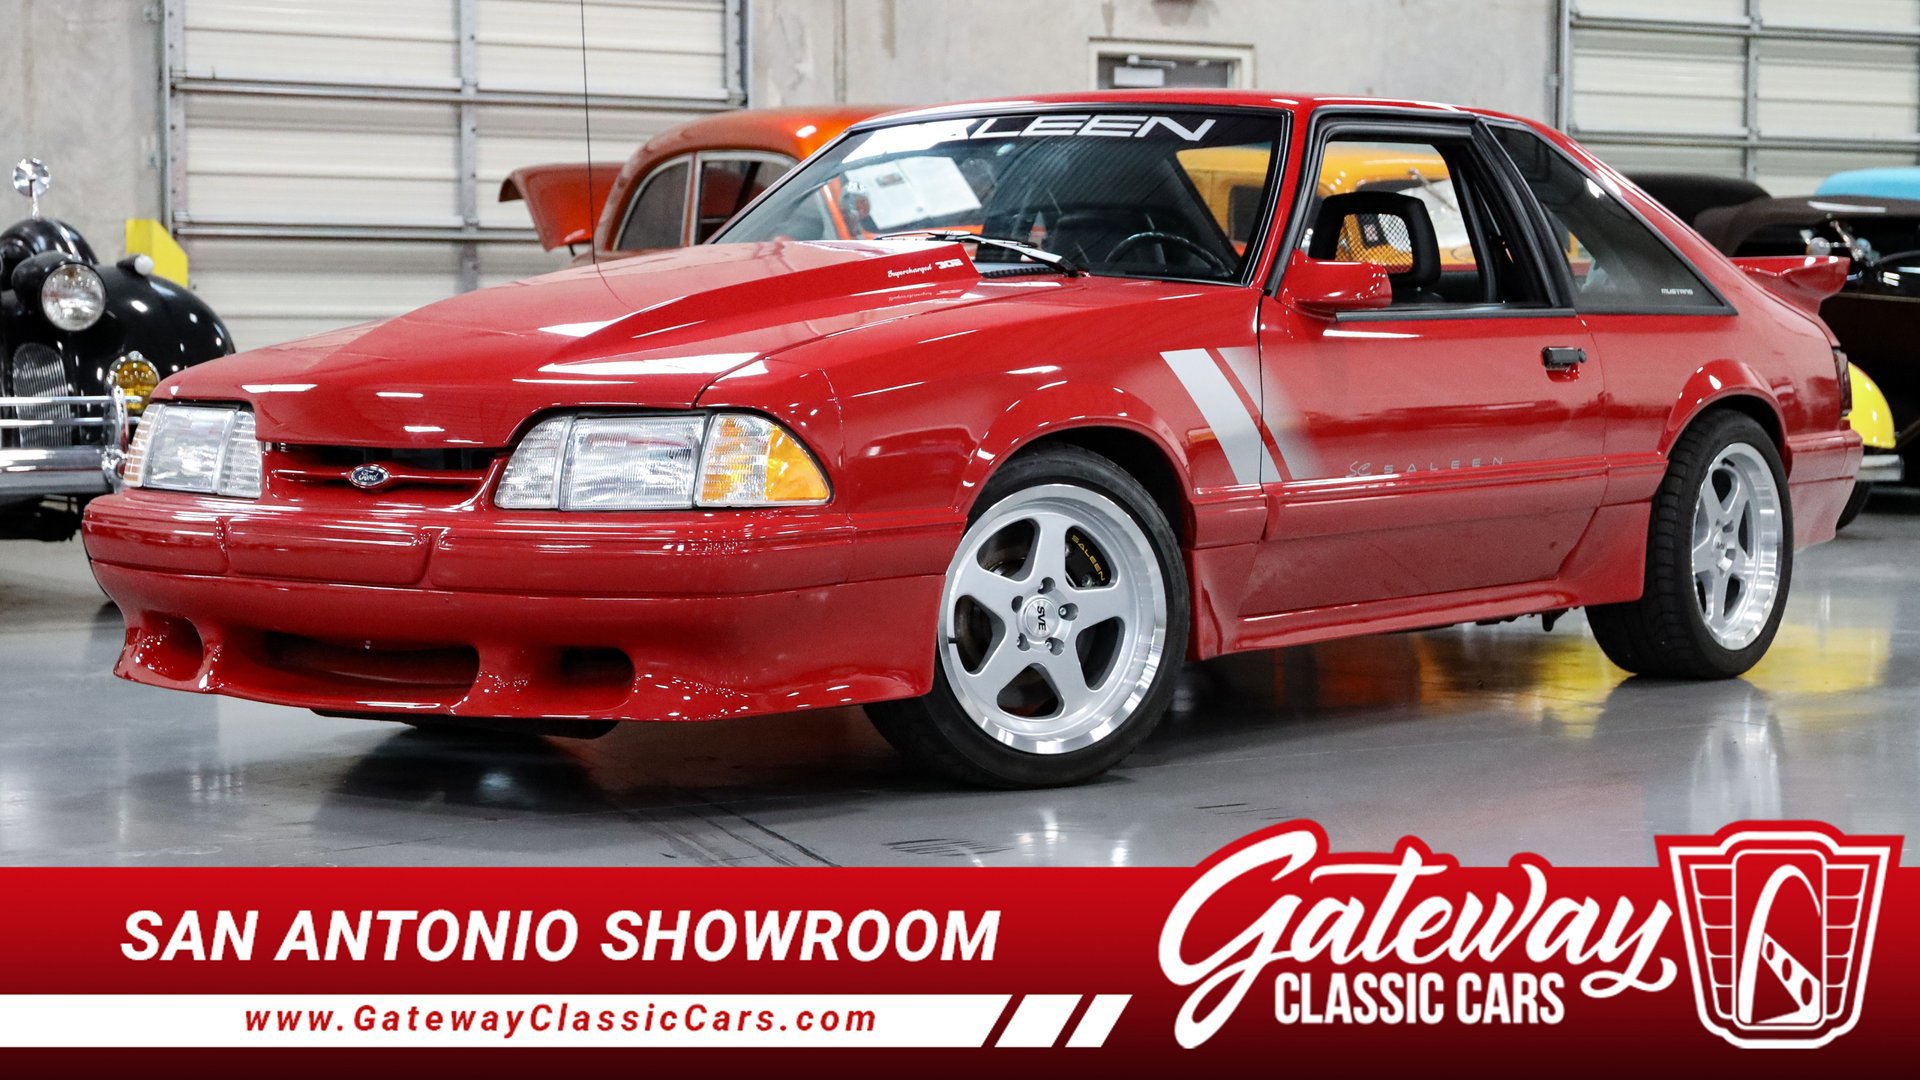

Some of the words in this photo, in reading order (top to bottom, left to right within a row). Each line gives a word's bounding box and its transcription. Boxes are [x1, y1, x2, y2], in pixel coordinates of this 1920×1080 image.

[887, 264, 932, 278] Supercharged
[1384, 457, 1503, 474] SALEEN
[1071, 534, 1106, 582] SALEEN
[1036, 605, 1047, 631] SVE
